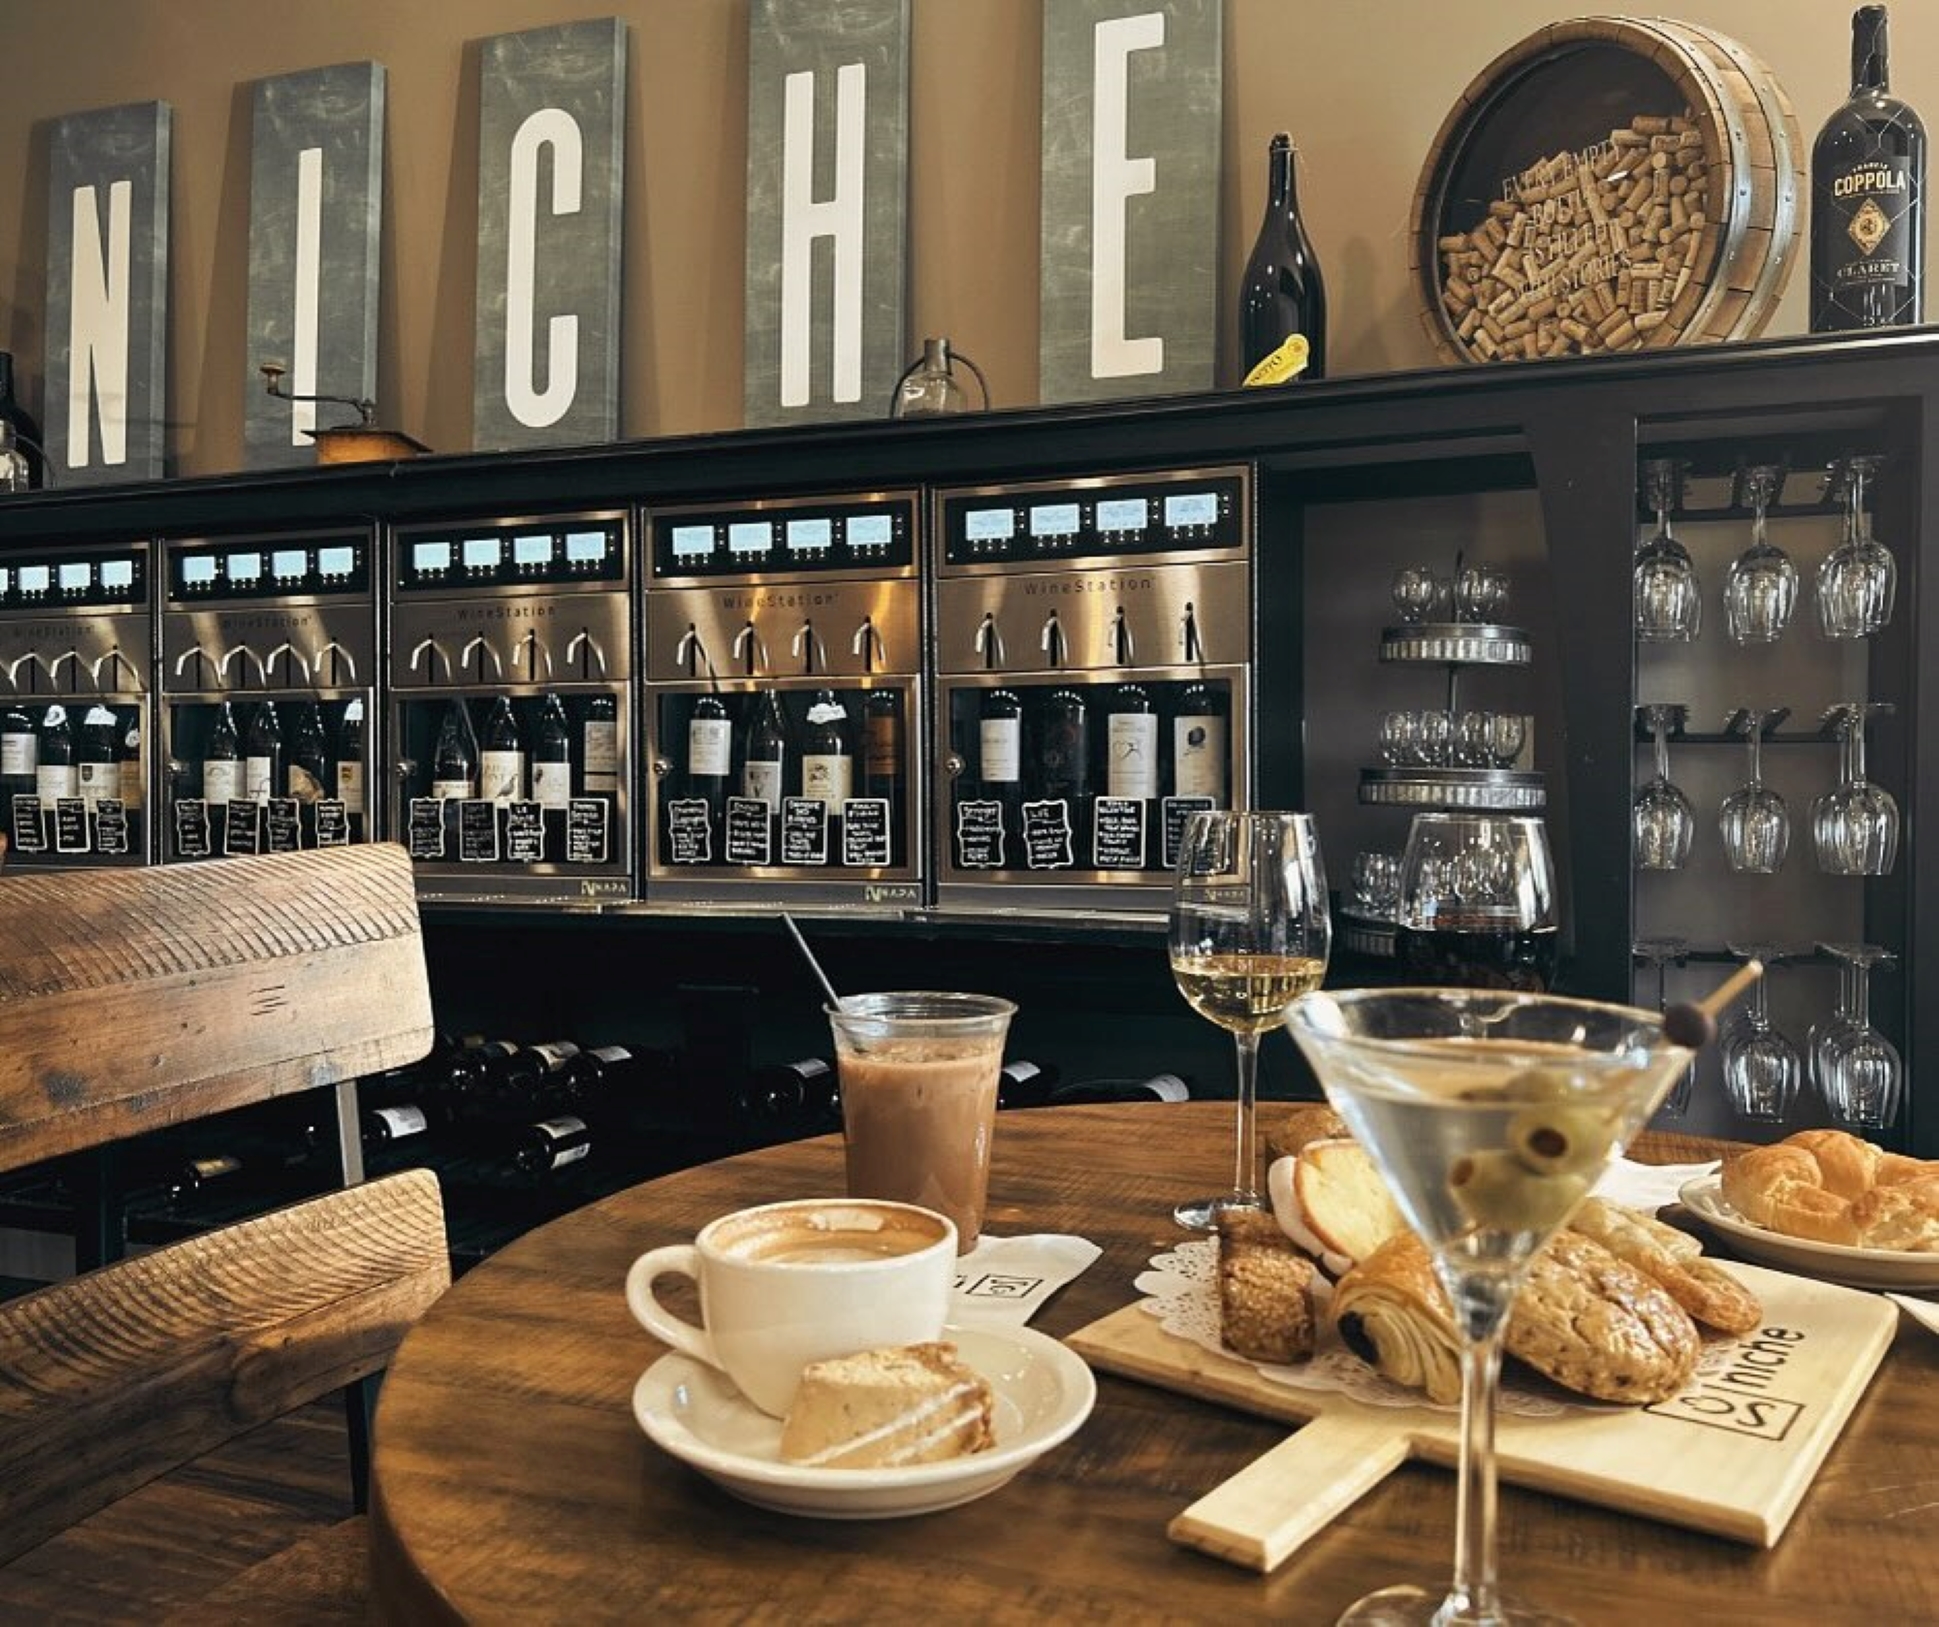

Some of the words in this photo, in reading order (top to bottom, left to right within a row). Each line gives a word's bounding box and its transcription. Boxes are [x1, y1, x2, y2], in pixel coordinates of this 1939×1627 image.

[1834, 170, 1906, 197] COPPOLA
[68, 12, 1165, 468] NICHE
[1836, 262, 1901, 279] CLARET
[1721, 1326, 1805, 1390] niche
